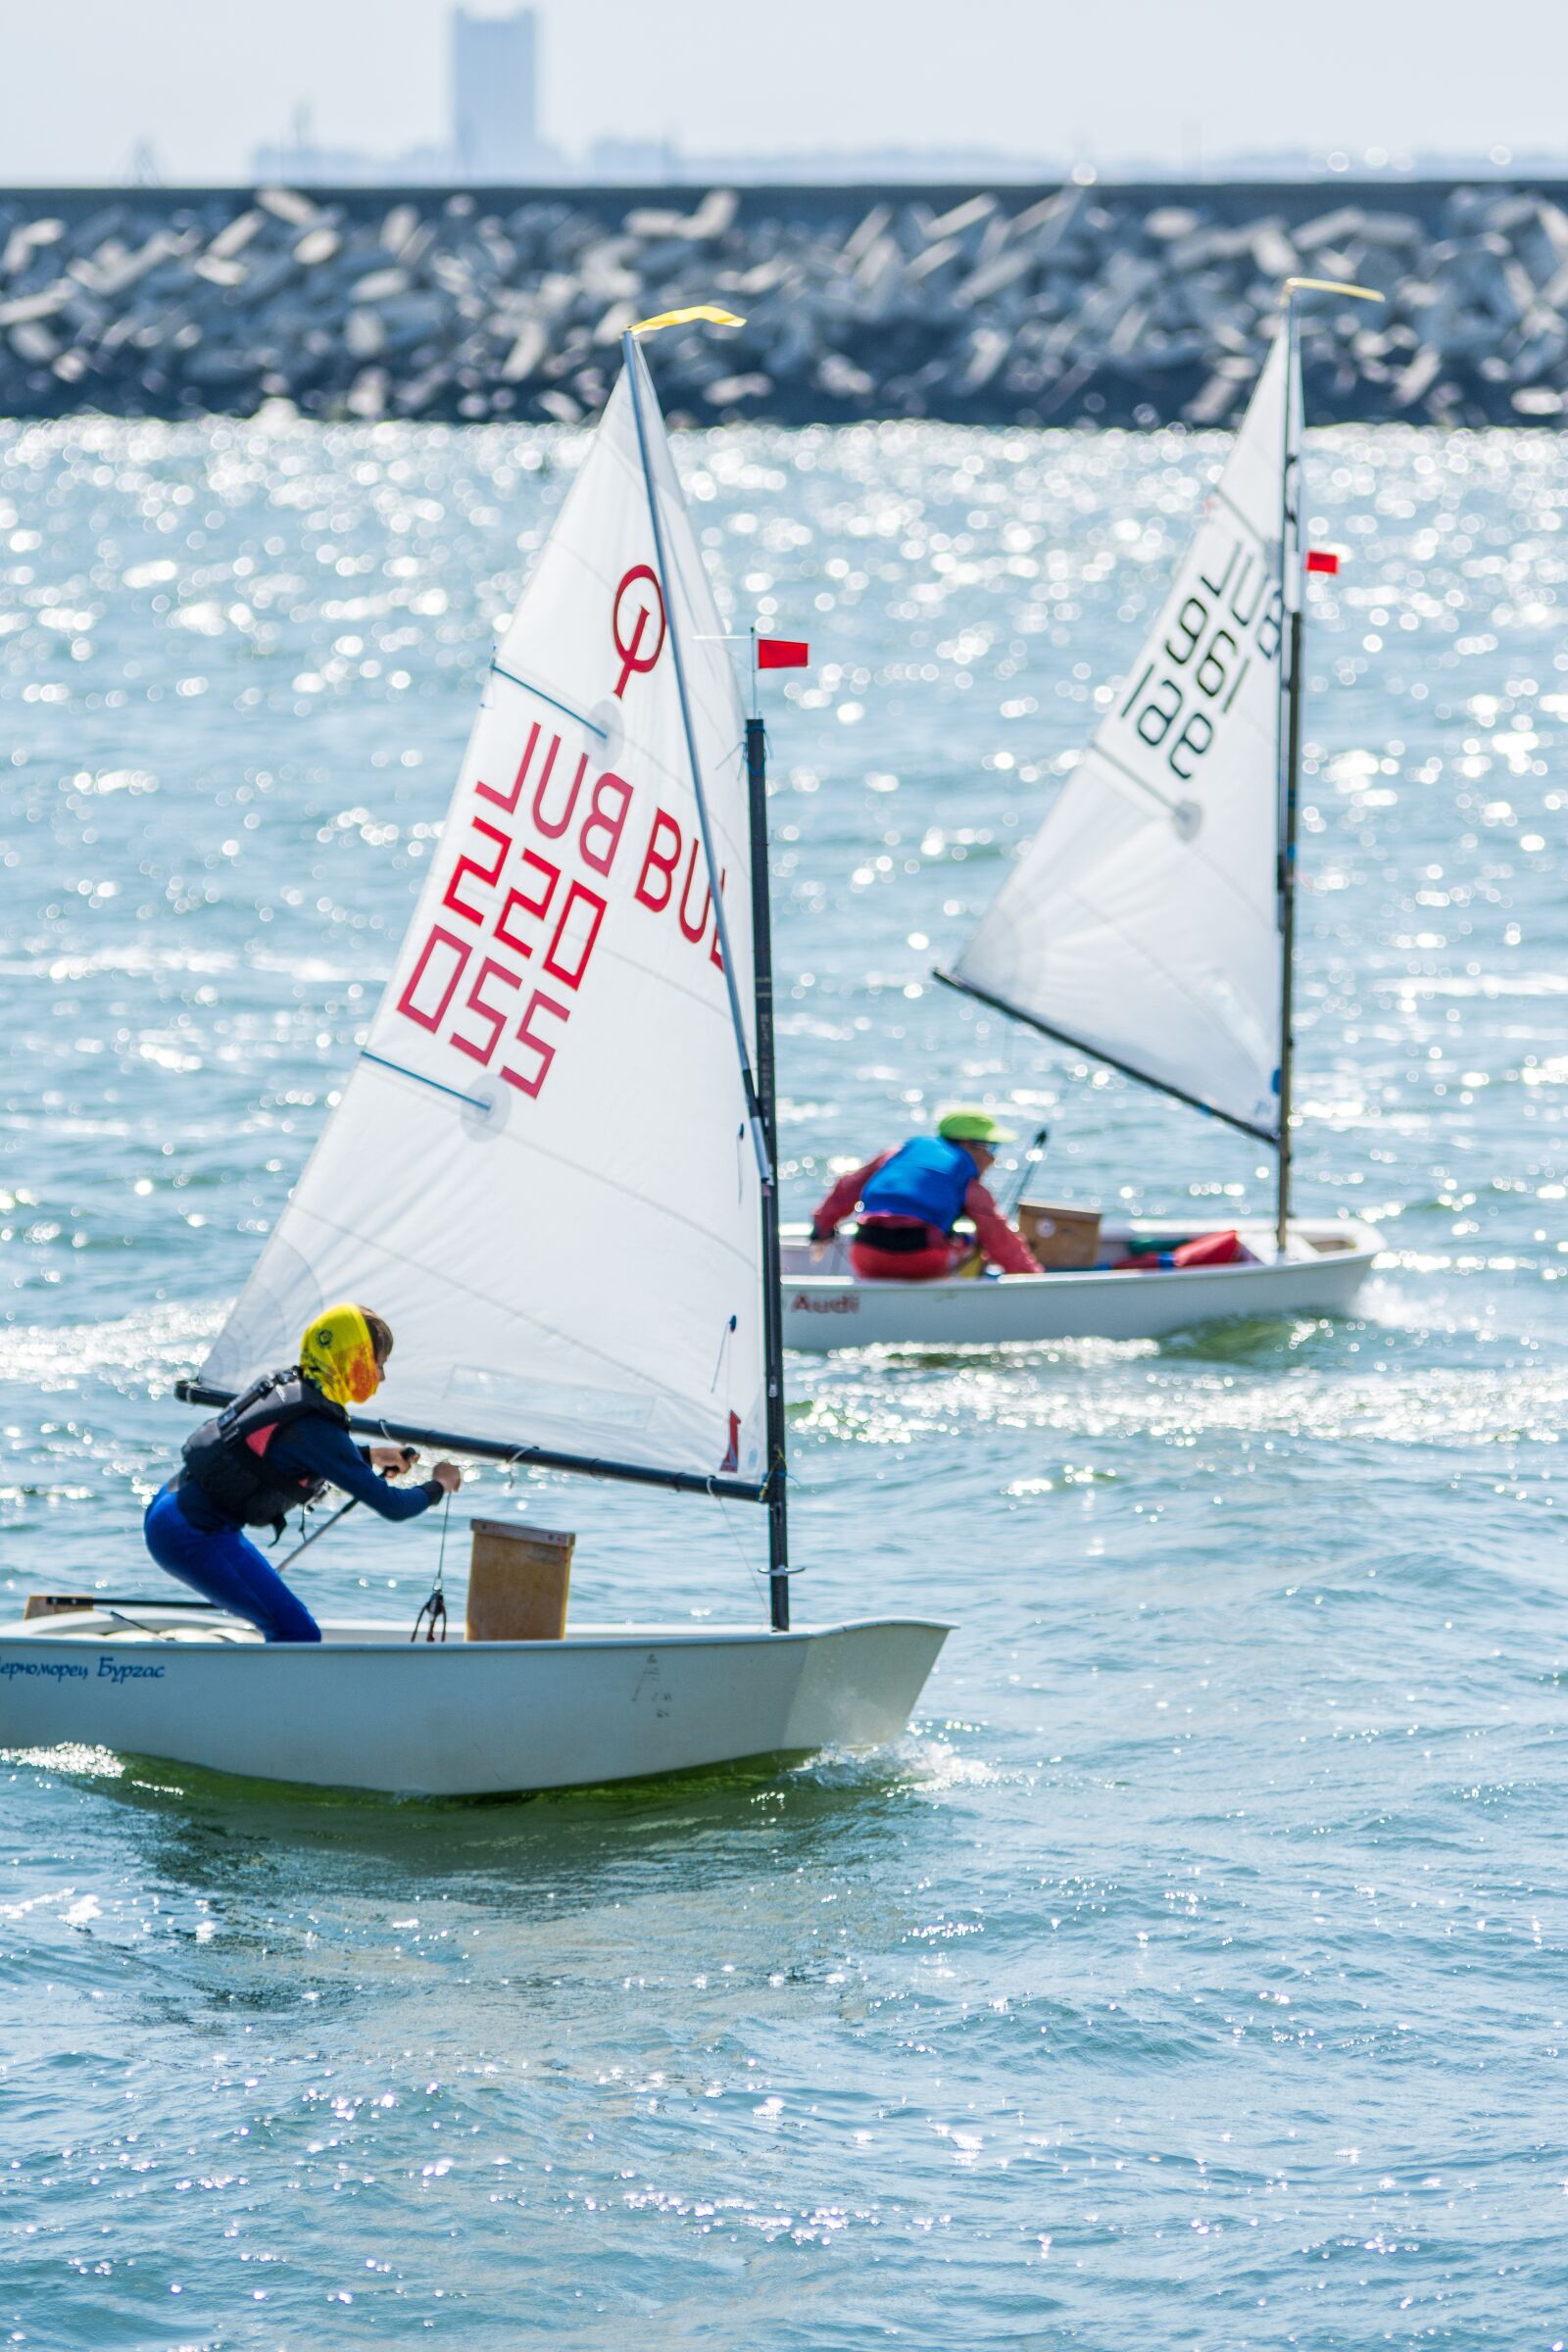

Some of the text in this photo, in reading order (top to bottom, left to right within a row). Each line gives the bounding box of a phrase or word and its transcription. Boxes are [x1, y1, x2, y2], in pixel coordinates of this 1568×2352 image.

[443, 815, 608, 992] 220
[791, 1293, 859, 1314] Audi
[0, 1655, 88, 1683] ерноморец
